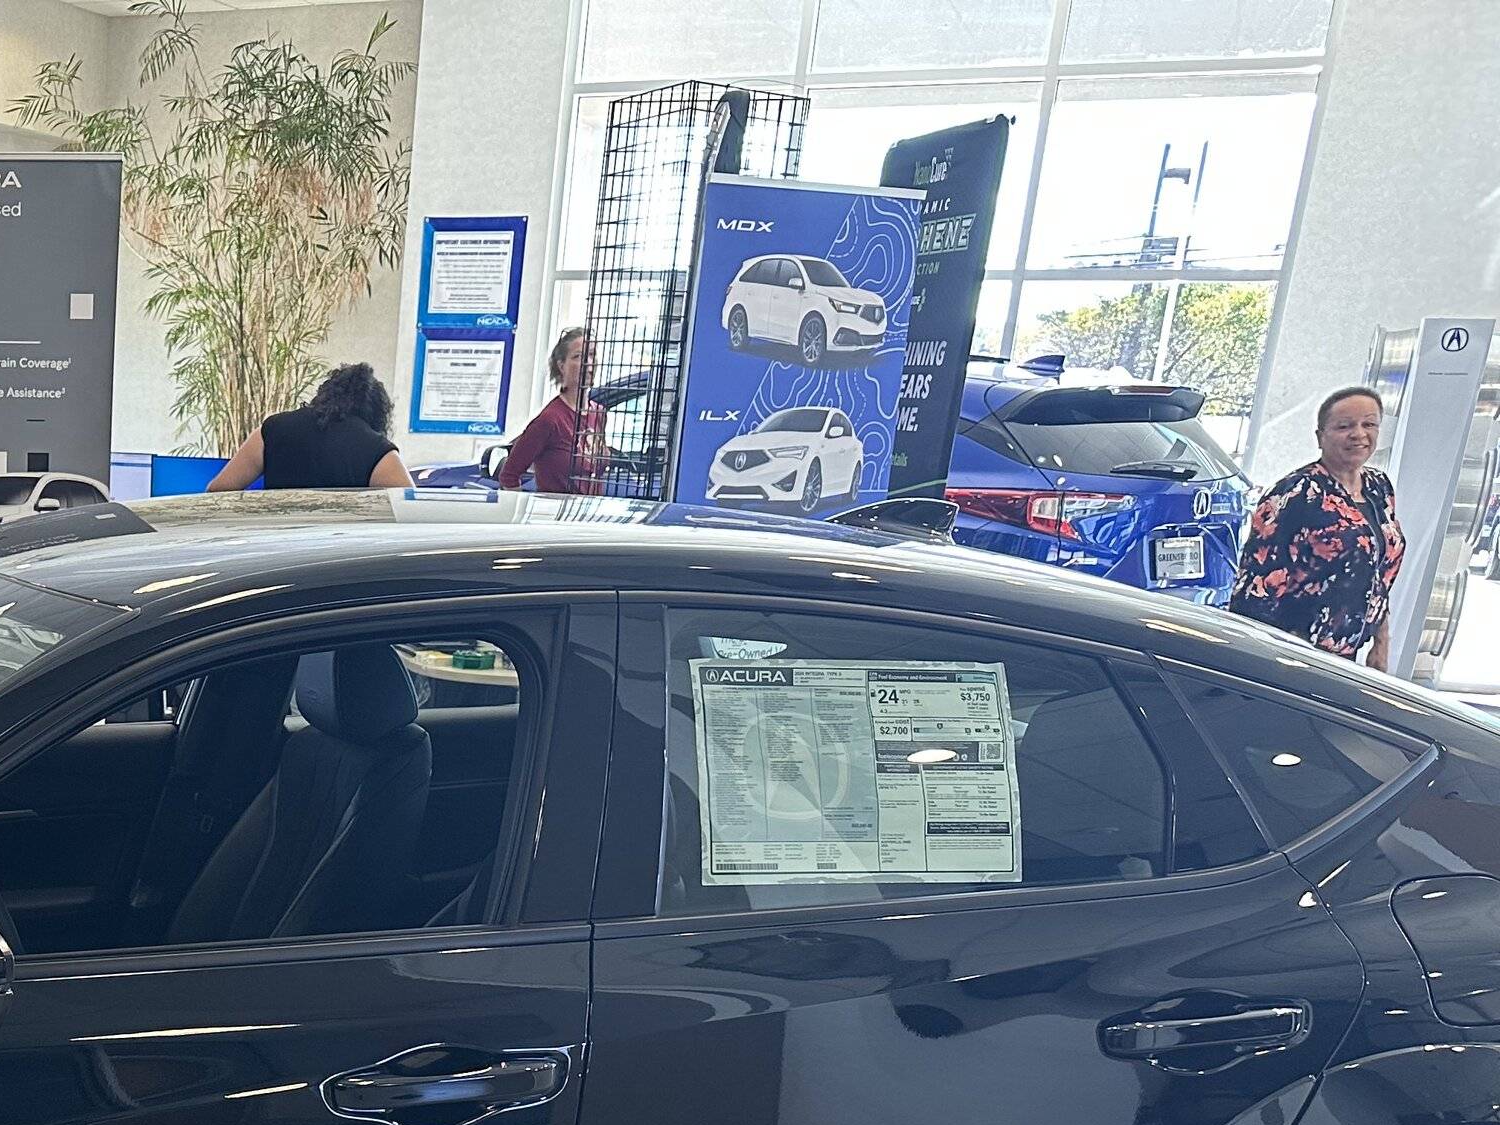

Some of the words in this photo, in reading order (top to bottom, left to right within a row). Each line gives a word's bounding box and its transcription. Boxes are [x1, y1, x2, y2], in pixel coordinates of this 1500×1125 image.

[717, 218, 775, 233] MDX
[699, 409, 742, 421] ILX
[1158, 551, 1199, 562] GREENSBRO
[720, 671, 787, 683] ACURA
[878, 689, 899, 704] 24
[960, 693, 991, 701] $3,750
[880, 727, 908, 735] $2,700
